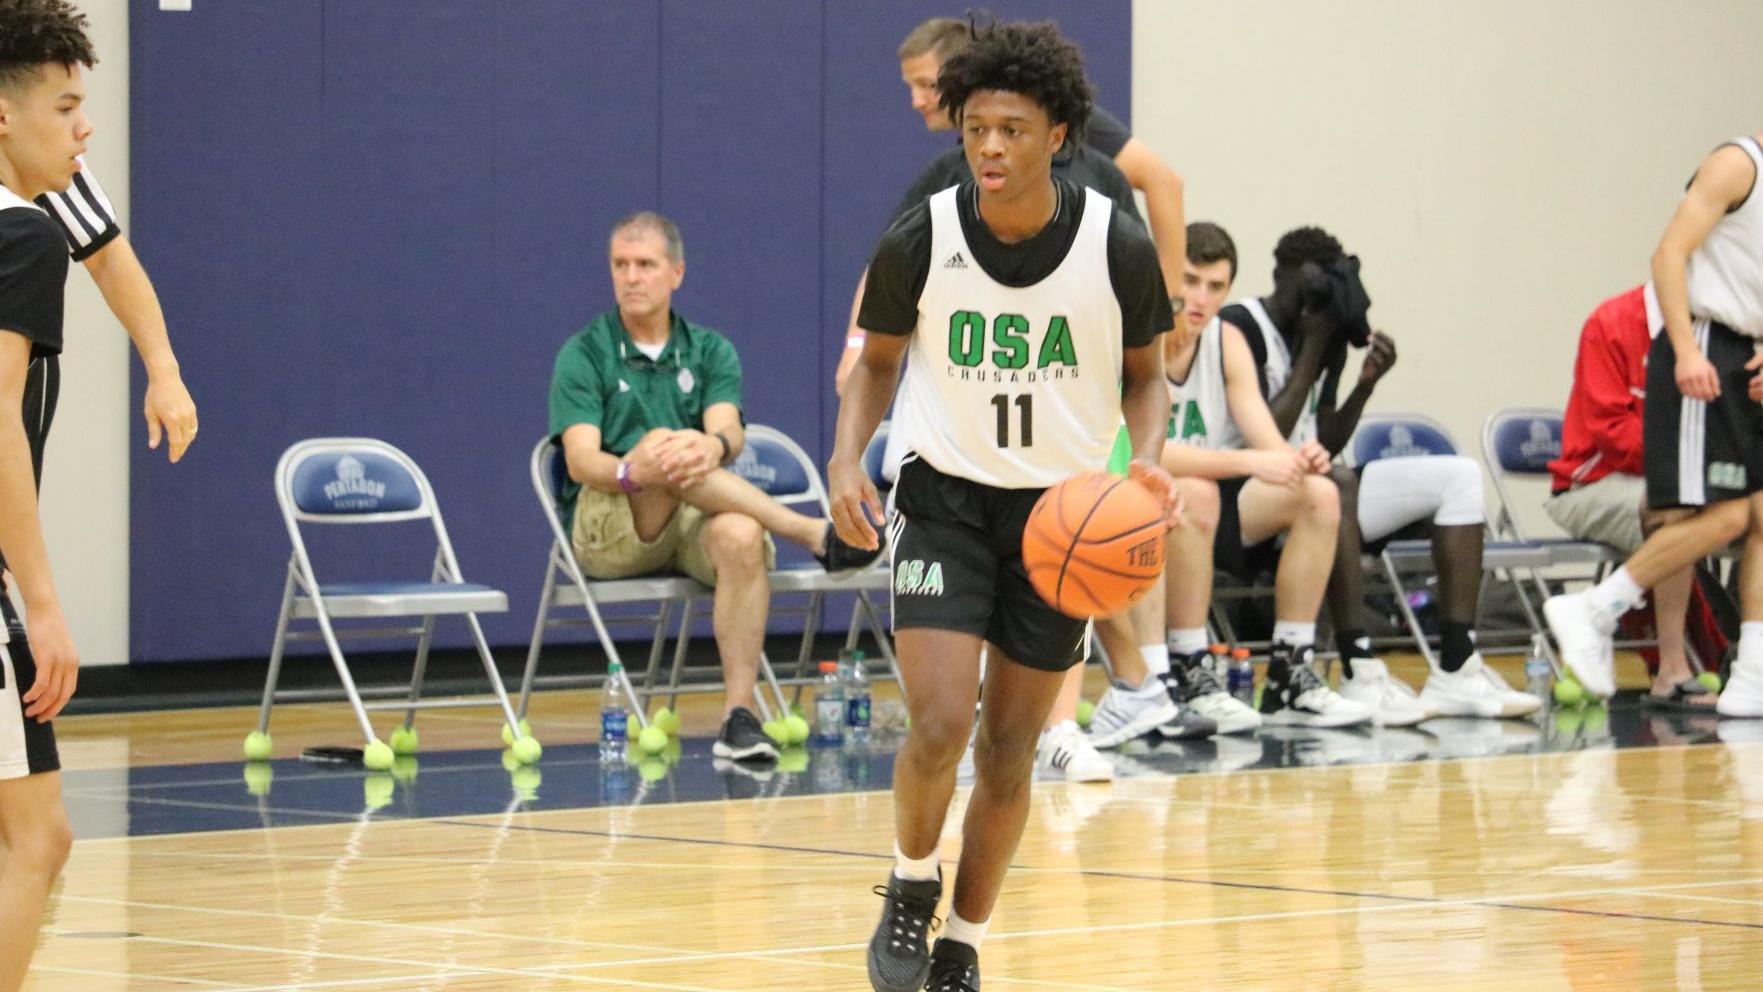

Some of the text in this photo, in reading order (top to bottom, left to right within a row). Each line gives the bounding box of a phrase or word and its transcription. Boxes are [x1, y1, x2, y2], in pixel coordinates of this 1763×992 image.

[948, 310, 1078, 370] OSA
[947, 366, 1079, 382] CRUSADERS
[991, 394, 1033, 449] 11
